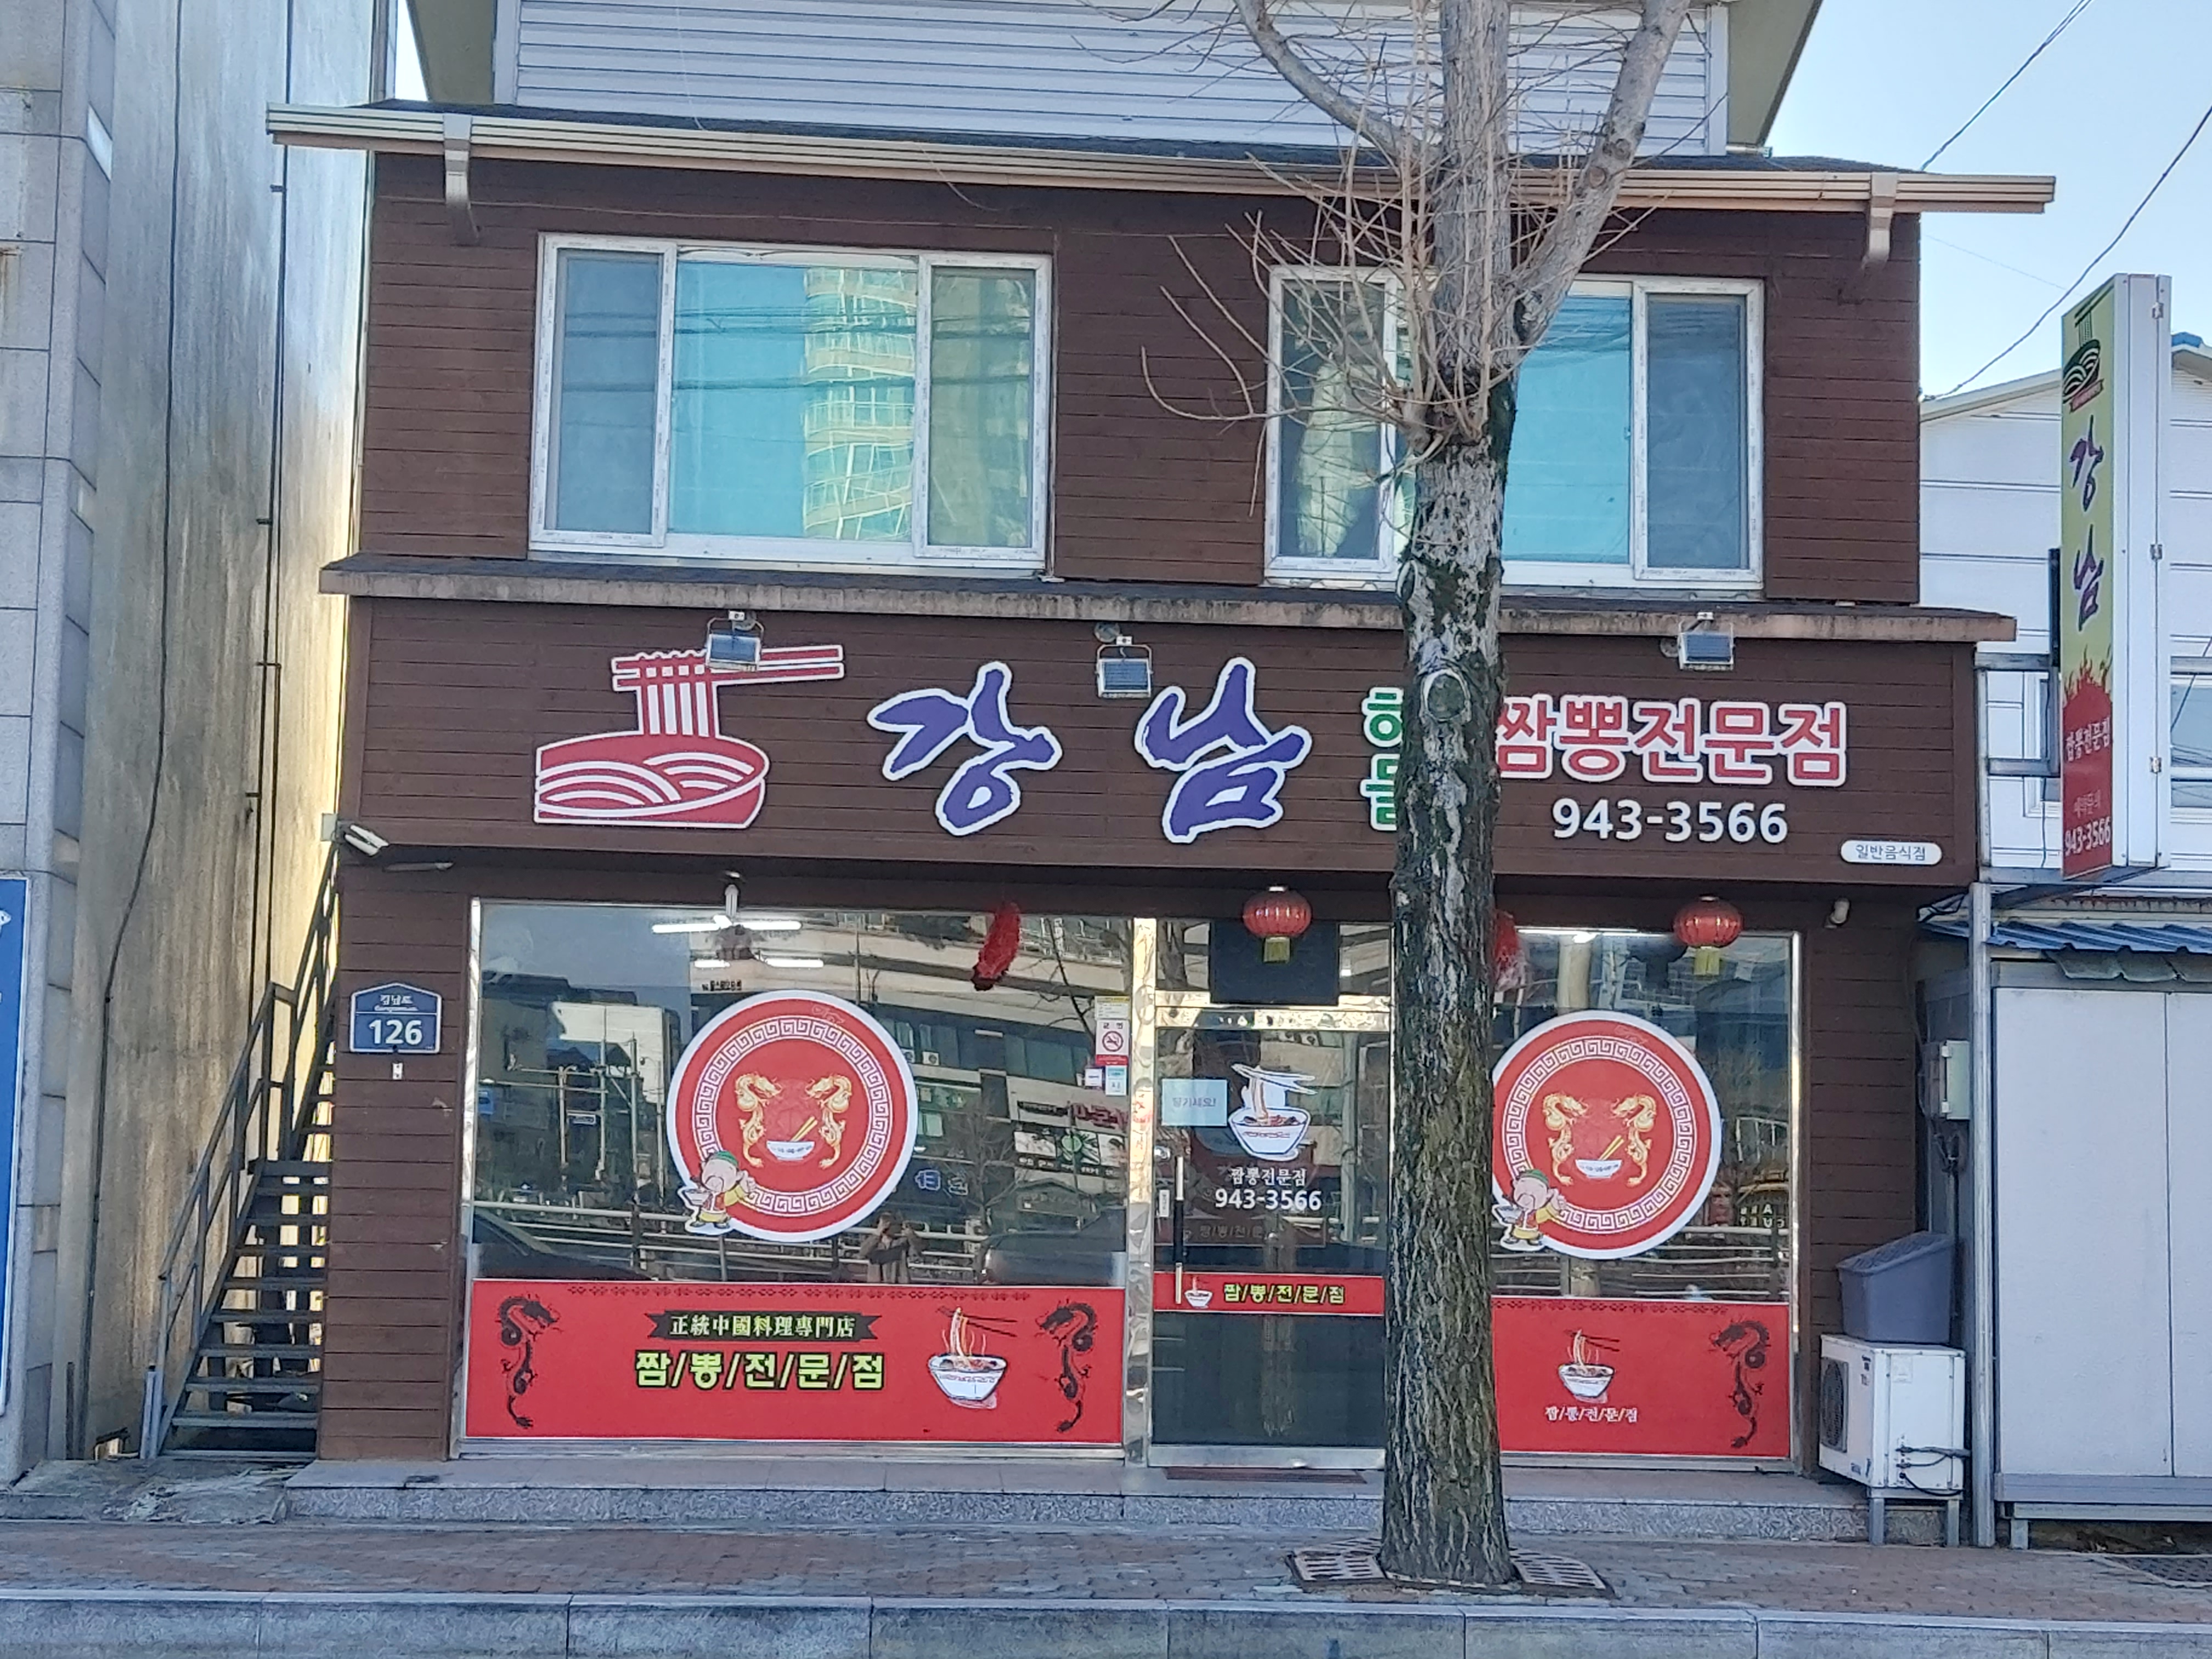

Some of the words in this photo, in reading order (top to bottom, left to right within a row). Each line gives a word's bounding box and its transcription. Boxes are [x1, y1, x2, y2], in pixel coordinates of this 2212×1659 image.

[1496, 693, 1847, 787] 짬뽕전문점
[1551, 798, 1788, 843] 943-3566
[2064, 816, 2111, 856] 943-3566
[1855, 844, 1926, 861] 일반음식점
[369, 1019, 422, 1045] 126
[1229, 1166, 1307, 1187] 짬뽕전문점
[1215, 1188, 1322, 1211] 943-3566
[669, 1314, 856, 1338] 正統中國料理專門店
